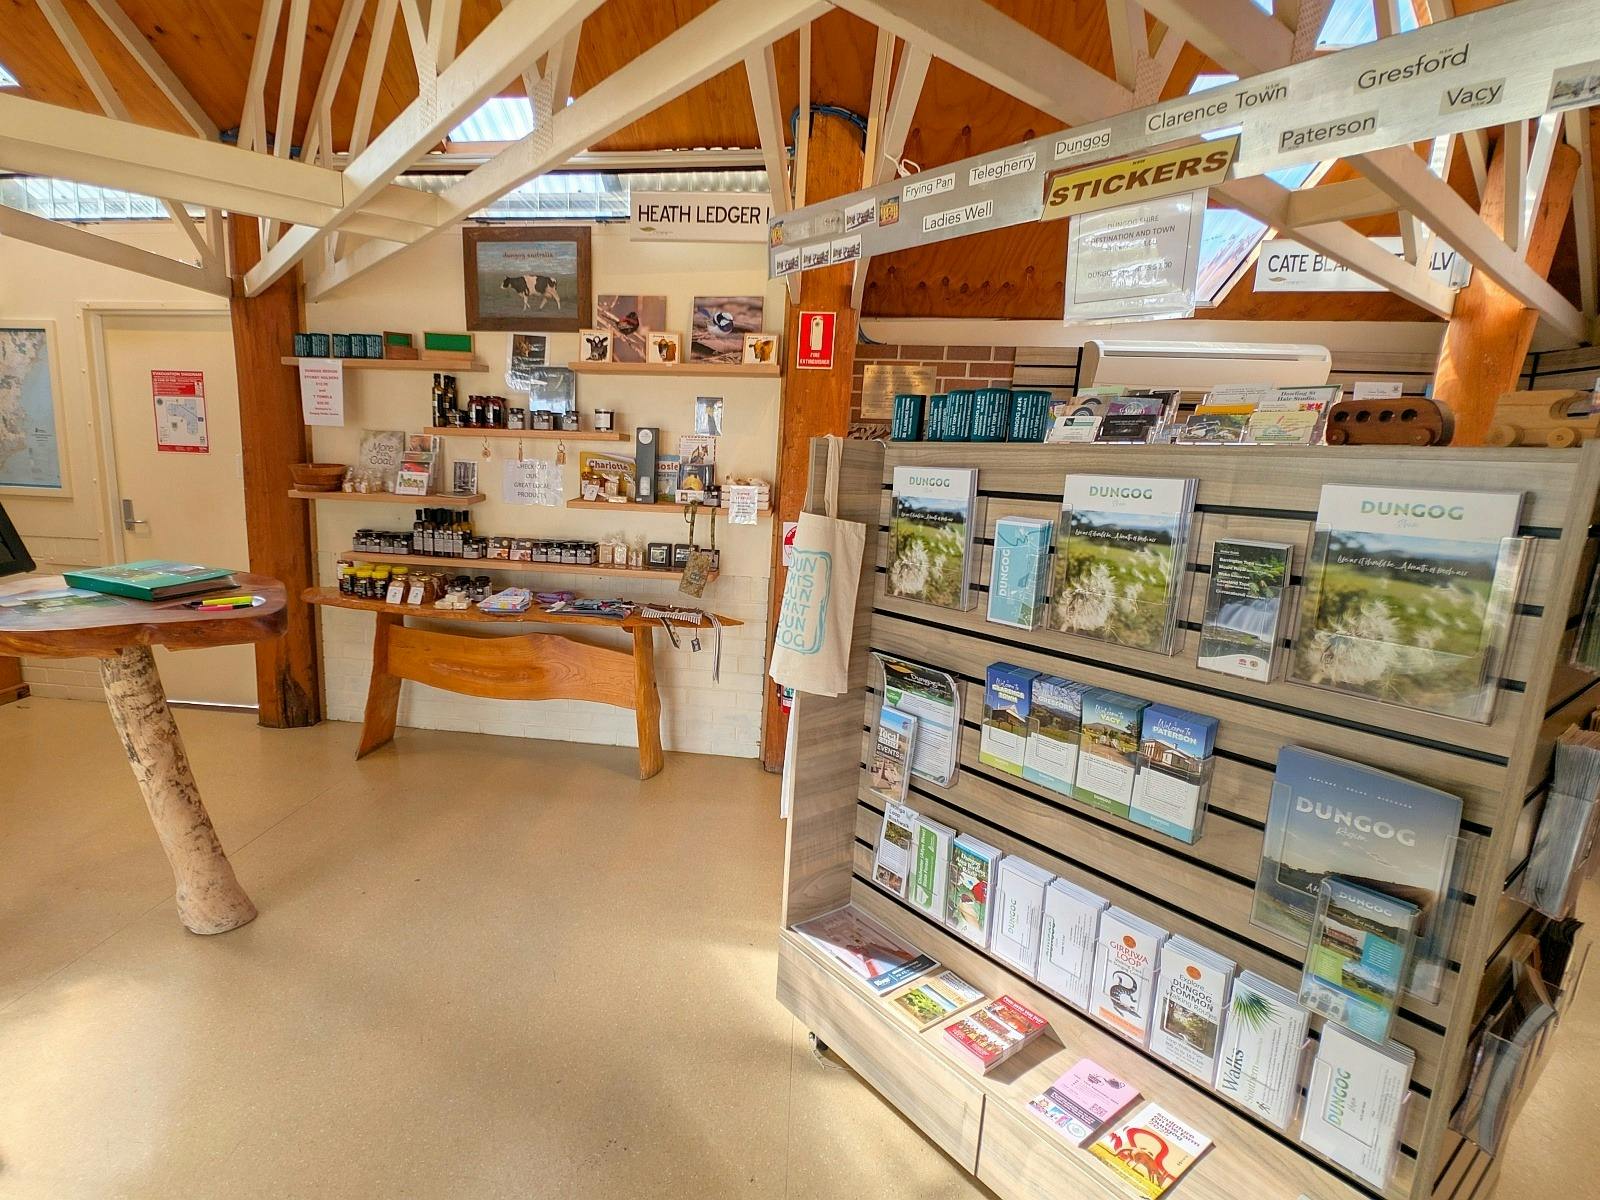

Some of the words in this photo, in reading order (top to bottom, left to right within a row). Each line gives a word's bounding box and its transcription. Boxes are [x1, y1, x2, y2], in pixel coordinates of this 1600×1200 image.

[1358, 44, 1470, 90] Gresford
[1446, 83, 1502, 106] Vacy
[1148, 100, 1228, 131] Clarence
[1236, 84, 1288, 110] Town
[1281, 114, 1376, 148] Paterson
[1056, 132, 1110, 156] Dungog
[971, 156, 1035, 182] Telegherry
[1050, 151, 1229, 206] STICKERS
[905, 182, 934, 199] Frying
[936, 176, 953, 190] Pan
[638, 204, 690, 222] HEATH
[696, 205, 760, 224] LEDGER
[924, 211, 961, 231] Ladies
[964, 201, 992, 219] Well
[1135, 229, 1150, 238] AND
[1152, 225, 1176, 235] TOWN
[1268, 254, 1309, 273] CATE
[657, 462, 679, 471] osie
[909, 476, 950, 488] DUNGOG
[1088, 486, 1153, 500] DUNGOG
[1360, 500, 1464, 521] DUNGOG
[789, 573, 814, 588] HIS
[1000, 548, 1010, 598] DUNGOG
[784, 600, 810, 617] HAT
[1152, 726, 1198, 745] PATERSON
[877, 744, 900, 758] EVENTS
[1296, 796, 1416, 847] DUNGOG
[1008, 899, 1016, 934] DUNGOG
[1338, 892, 1392, 917] DUNGOG
[1110, 940, 1150, 966] GIRRIWA
[1116, 953, 1142, 968] LOOP
[1170, 985, 1214, 1012] COMMON
[1172, 978, 1212, 1004] DUNGOG
[1222, 1048, 1244, 1092] Walks
[1328, 1068, 1352, 1126] DUNGOG
